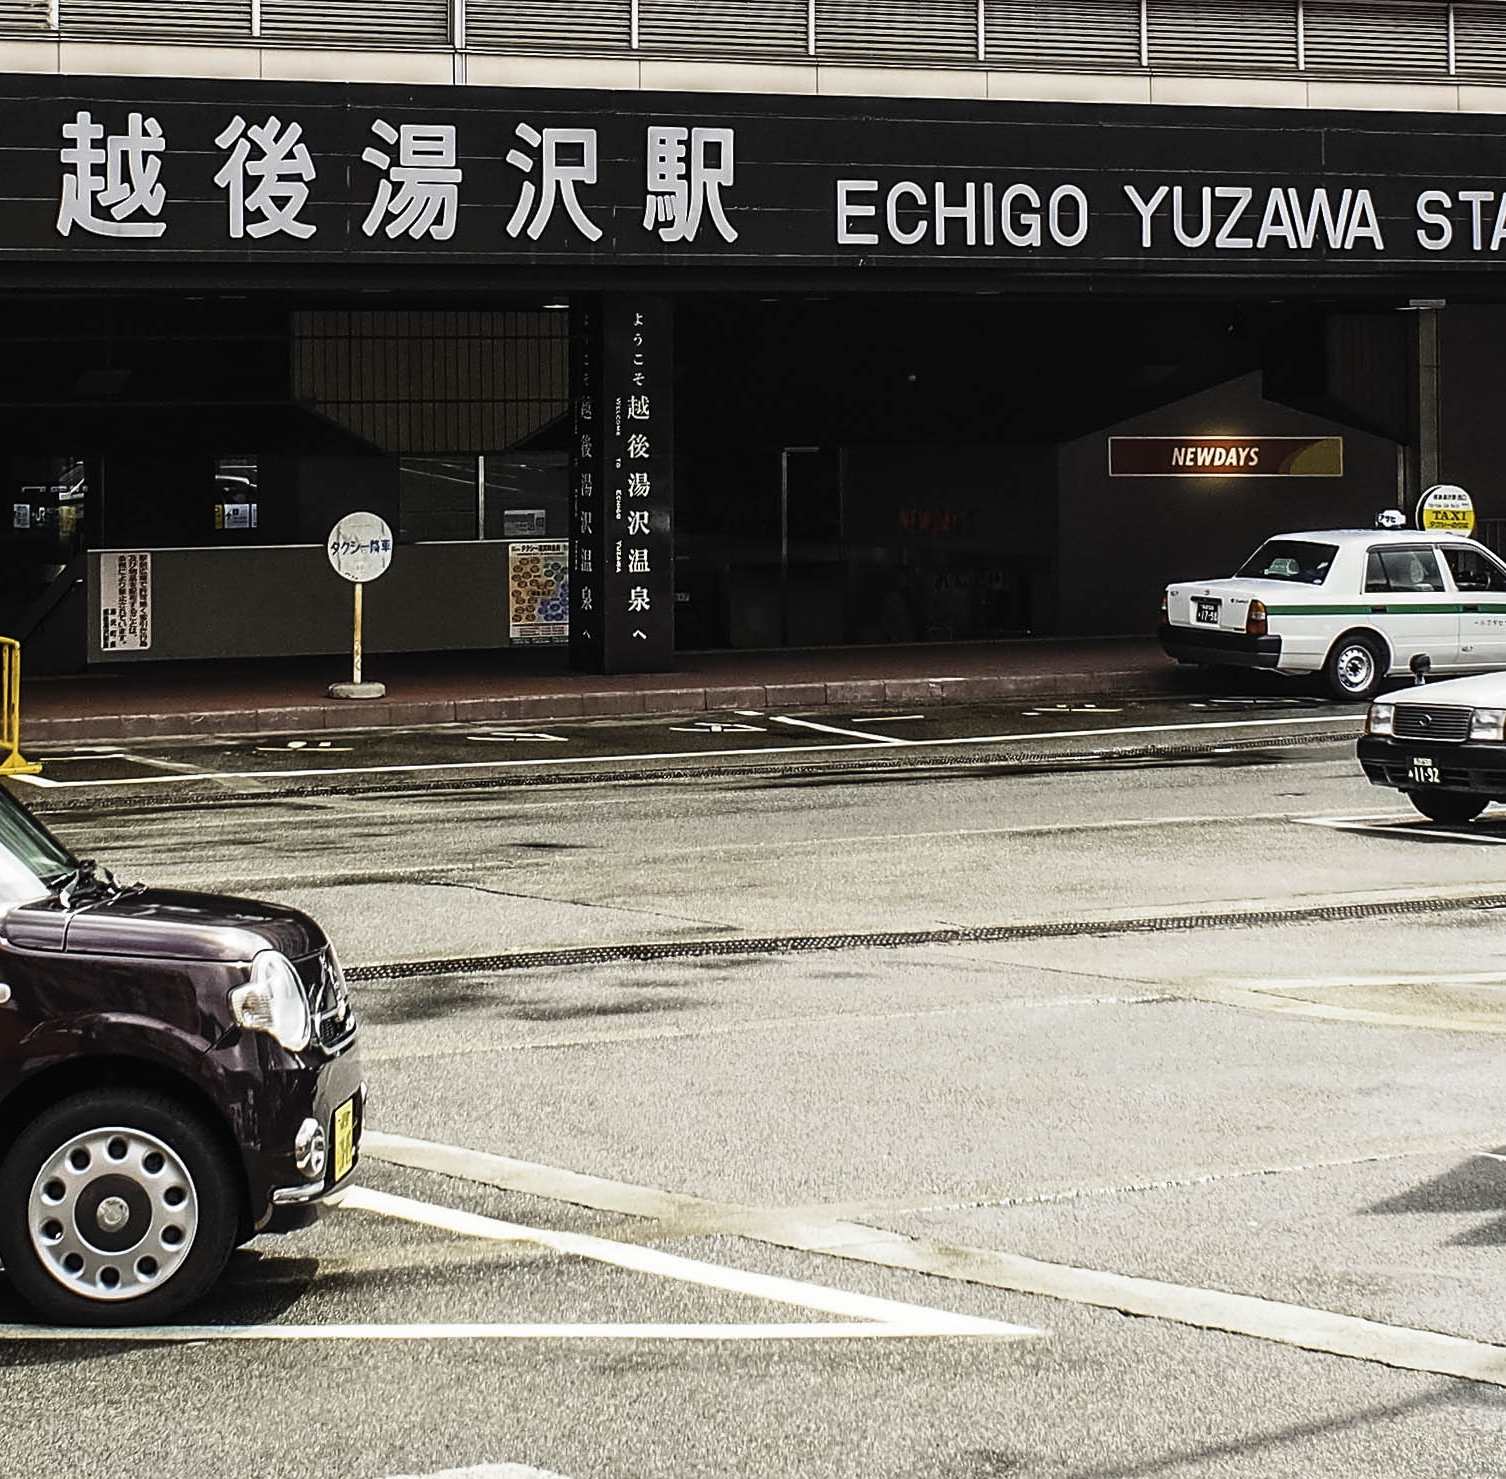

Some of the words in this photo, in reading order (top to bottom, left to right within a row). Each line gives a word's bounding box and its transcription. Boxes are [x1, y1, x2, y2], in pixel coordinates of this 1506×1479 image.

[56, 111, 738, 242] 越後湯沢駅
[836, 180, 1088, 248] ECHIGO
[1124, 185, 1384, 251] YUZAWA
[1171, 447, 1260, 466] NEWDAYS
[1432, 511, 1467, 521] TAXI
